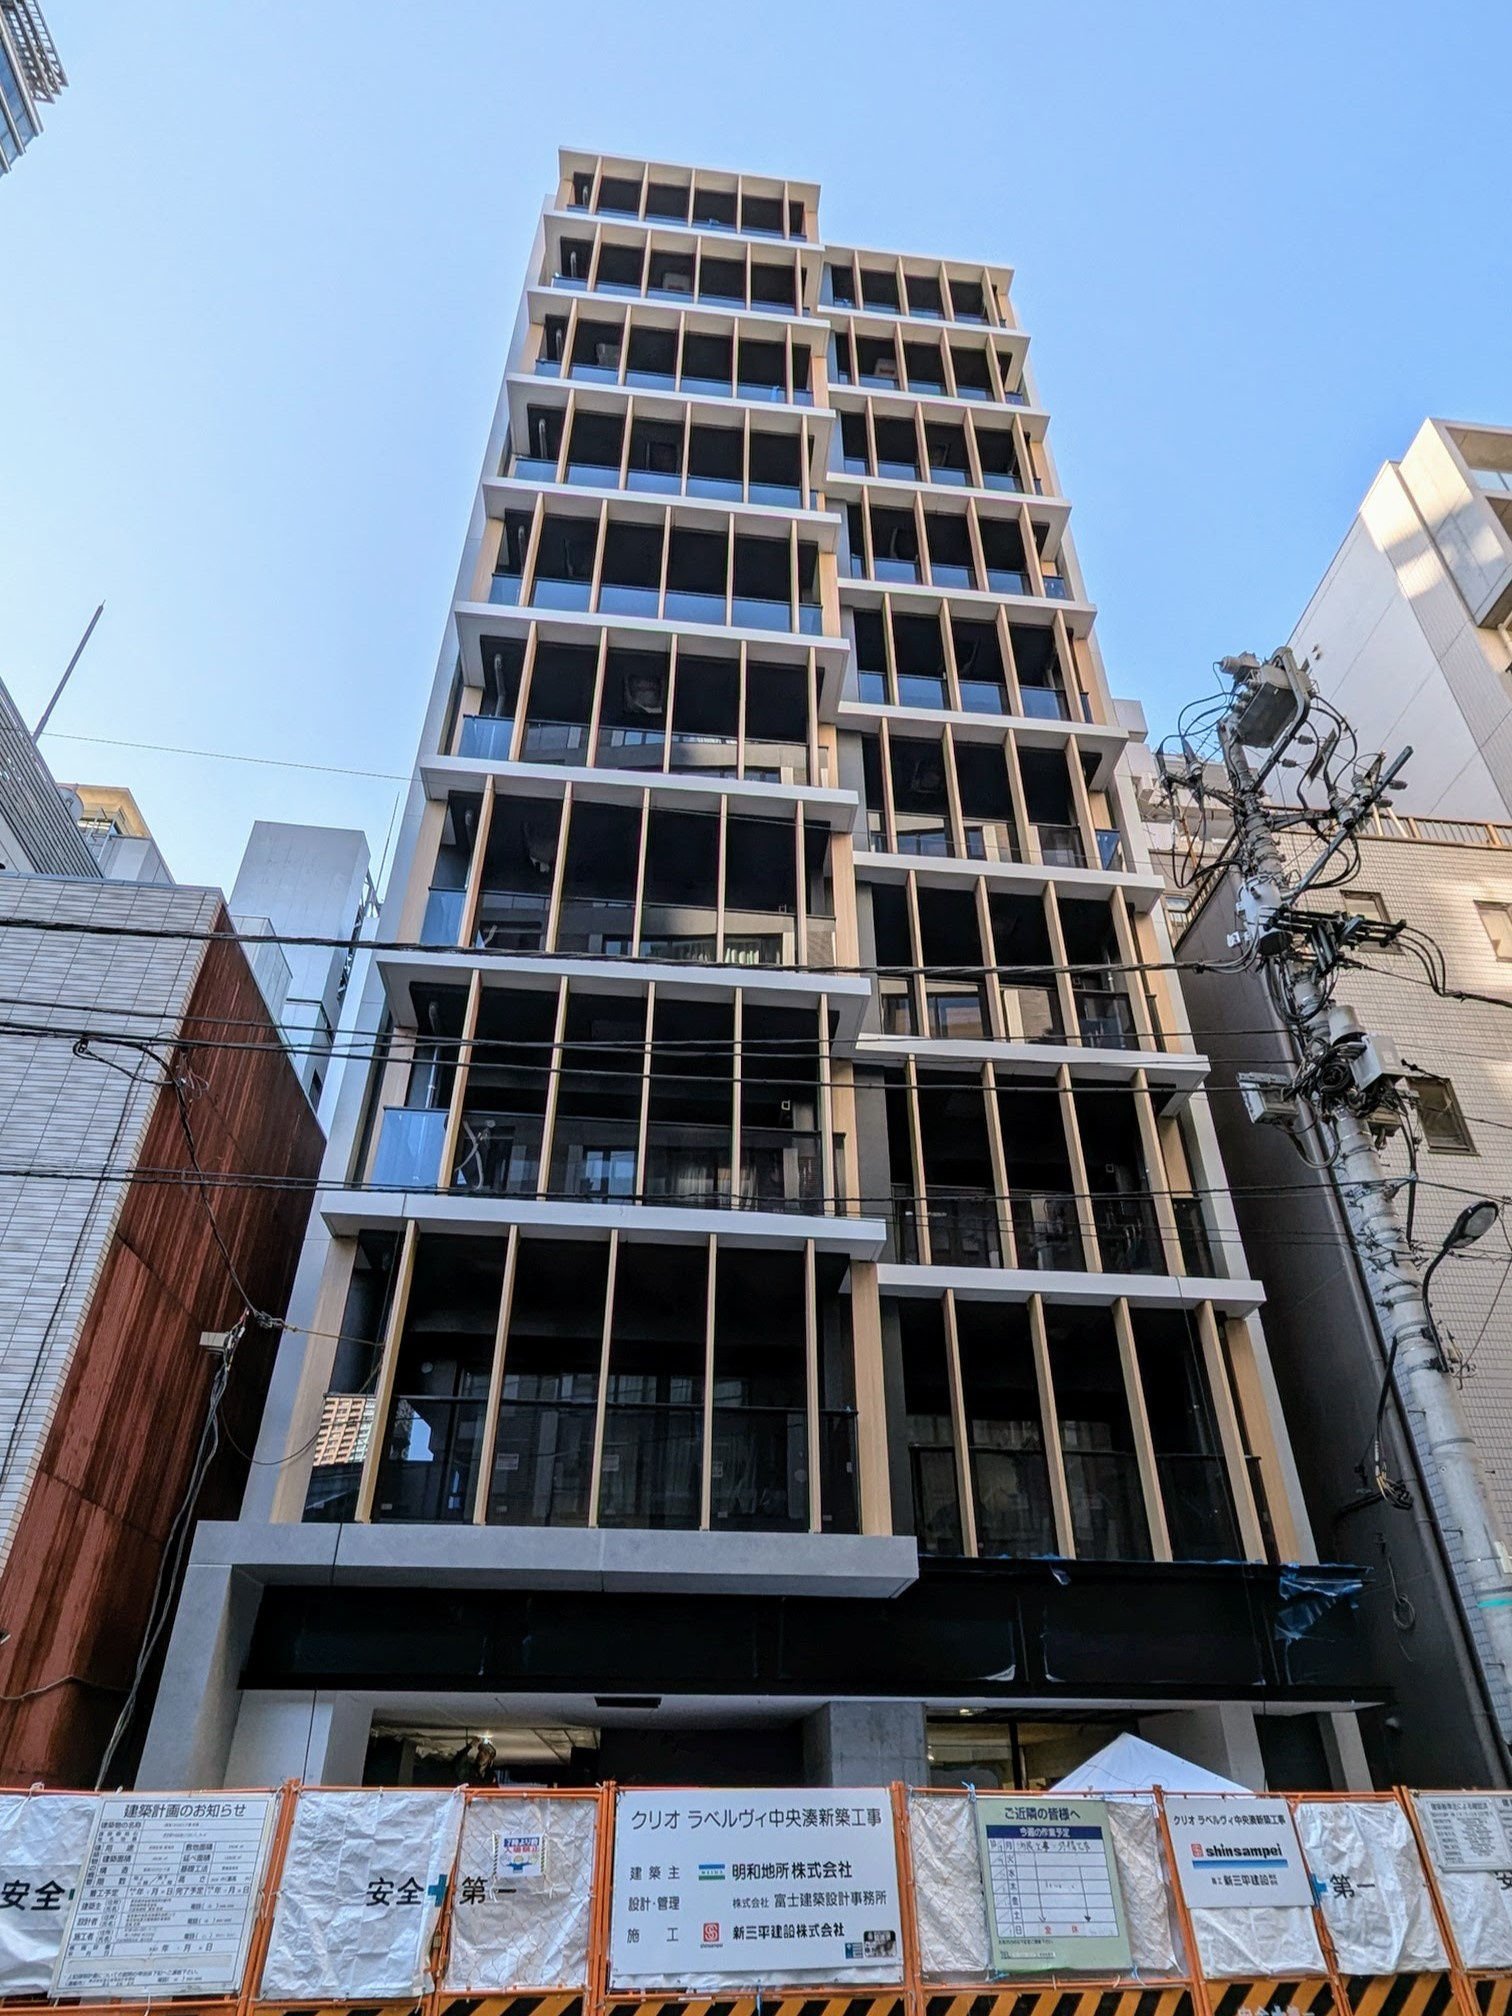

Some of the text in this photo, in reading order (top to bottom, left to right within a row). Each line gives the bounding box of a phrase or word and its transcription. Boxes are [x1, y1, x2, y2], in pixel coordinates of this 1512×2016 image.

[124, 1804, 246, 1818] 建築計画のお知らせ
[631, 1808, 882, 1830] クリオ ラベルヴィ中央湊新築工事
[1004, 1807, 1081, 1821] ご近隣の皆様へ
[1174, 1814, 1286, 1826] クリオ ラベルヴィ中央湊新築工事
[1206, 1842, 1283, 1858] shinsampei
[630, 1866, 680, 1881] 建築主
[732, 1861, 853, 1881] 明和地所株式会社
[0, 1879, 65, 1911] 安全
[366, 1877, 424, 1907] 安全
[459, 1876, 517, 1905] 第一
[1330, 1874, 1376, 1899] 第一
[732, 1898, 769, 1910] 株式会社
[774, 1890, 887, 1909] 富士建築設計事務所
[627, 1927, 679, 1943] 施工
[733, 1922, 845, 1941] 新三平建設株式会社
